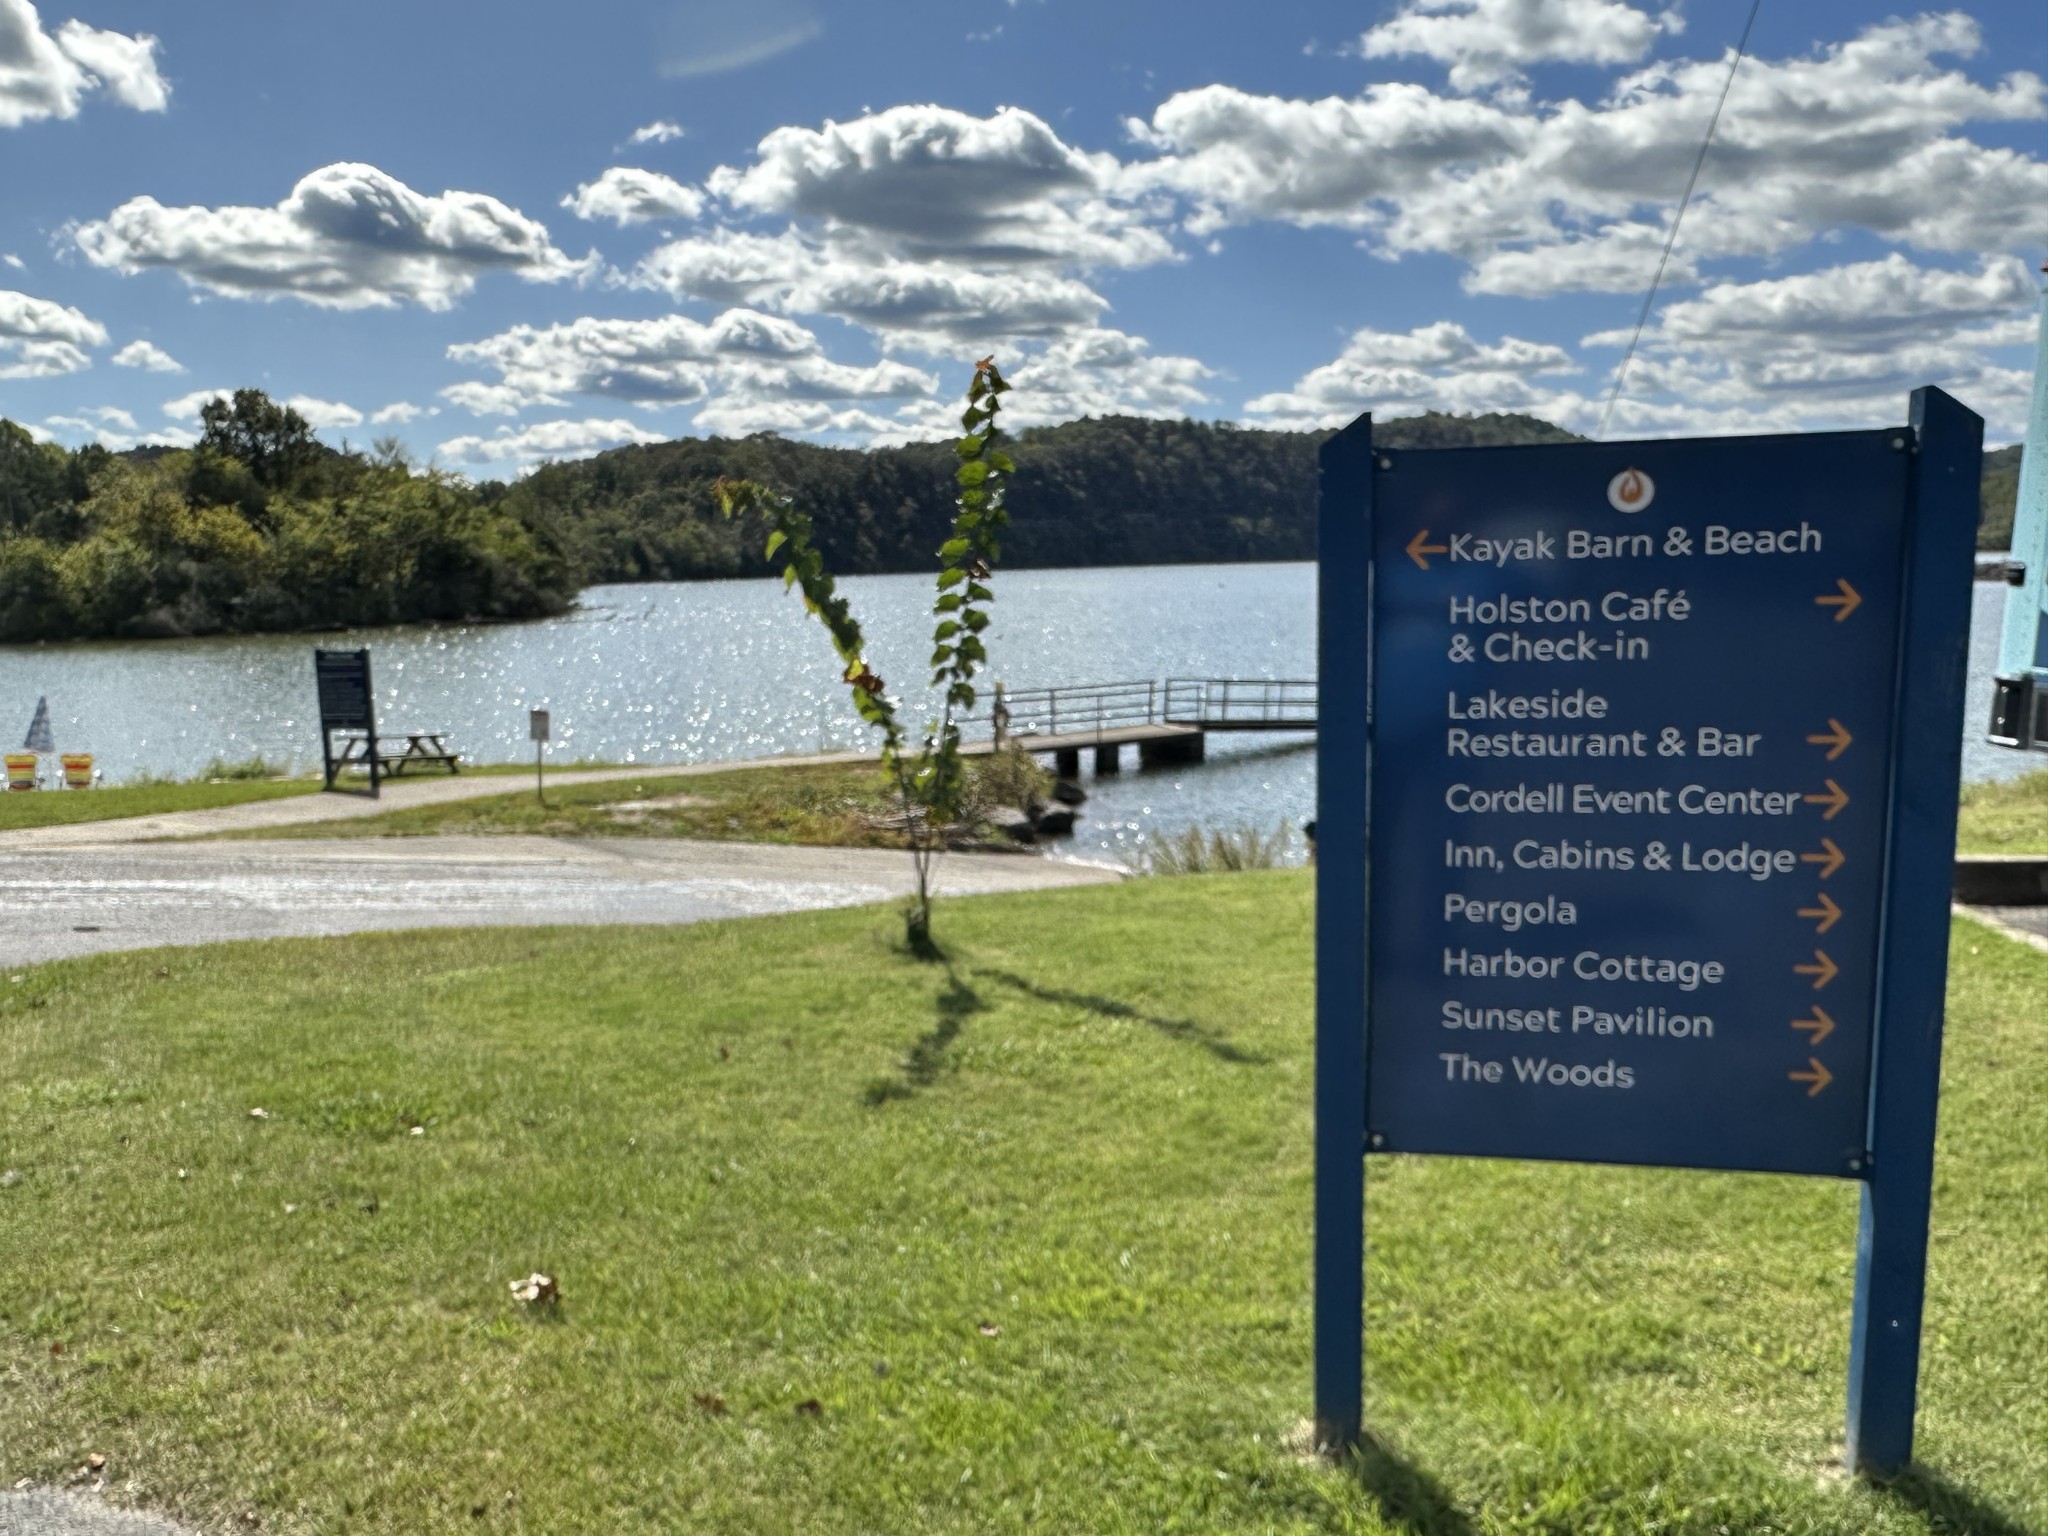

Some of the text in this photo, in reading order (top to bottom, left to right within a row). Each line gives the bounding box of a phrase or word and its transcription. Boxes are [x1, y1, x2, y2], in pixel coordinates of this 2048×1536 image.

[1451, 522, 1821, 567] Kayak Barn & Beach
[1450, 589, 1691, 624] Holston Café
[1448, 630, 1648, 662] & Check-in
[1449, 688, 1608, 719] Lakeside
[1448, 727, 1761, 757] Restaurant & Bar
[1446, 783, 1801, 815] Cordell Event Center
[1446, 839, 1796, 881] Inn, Cabins & Lodge
[1445, 894, 1576, 931] Pergola
[1444, 948, 1724, 991] Harbor Cottage
[1442, 1001, 1713, 1037] Sunset Pavilion
[1440, 1053, 1635, 1088] The Woods
